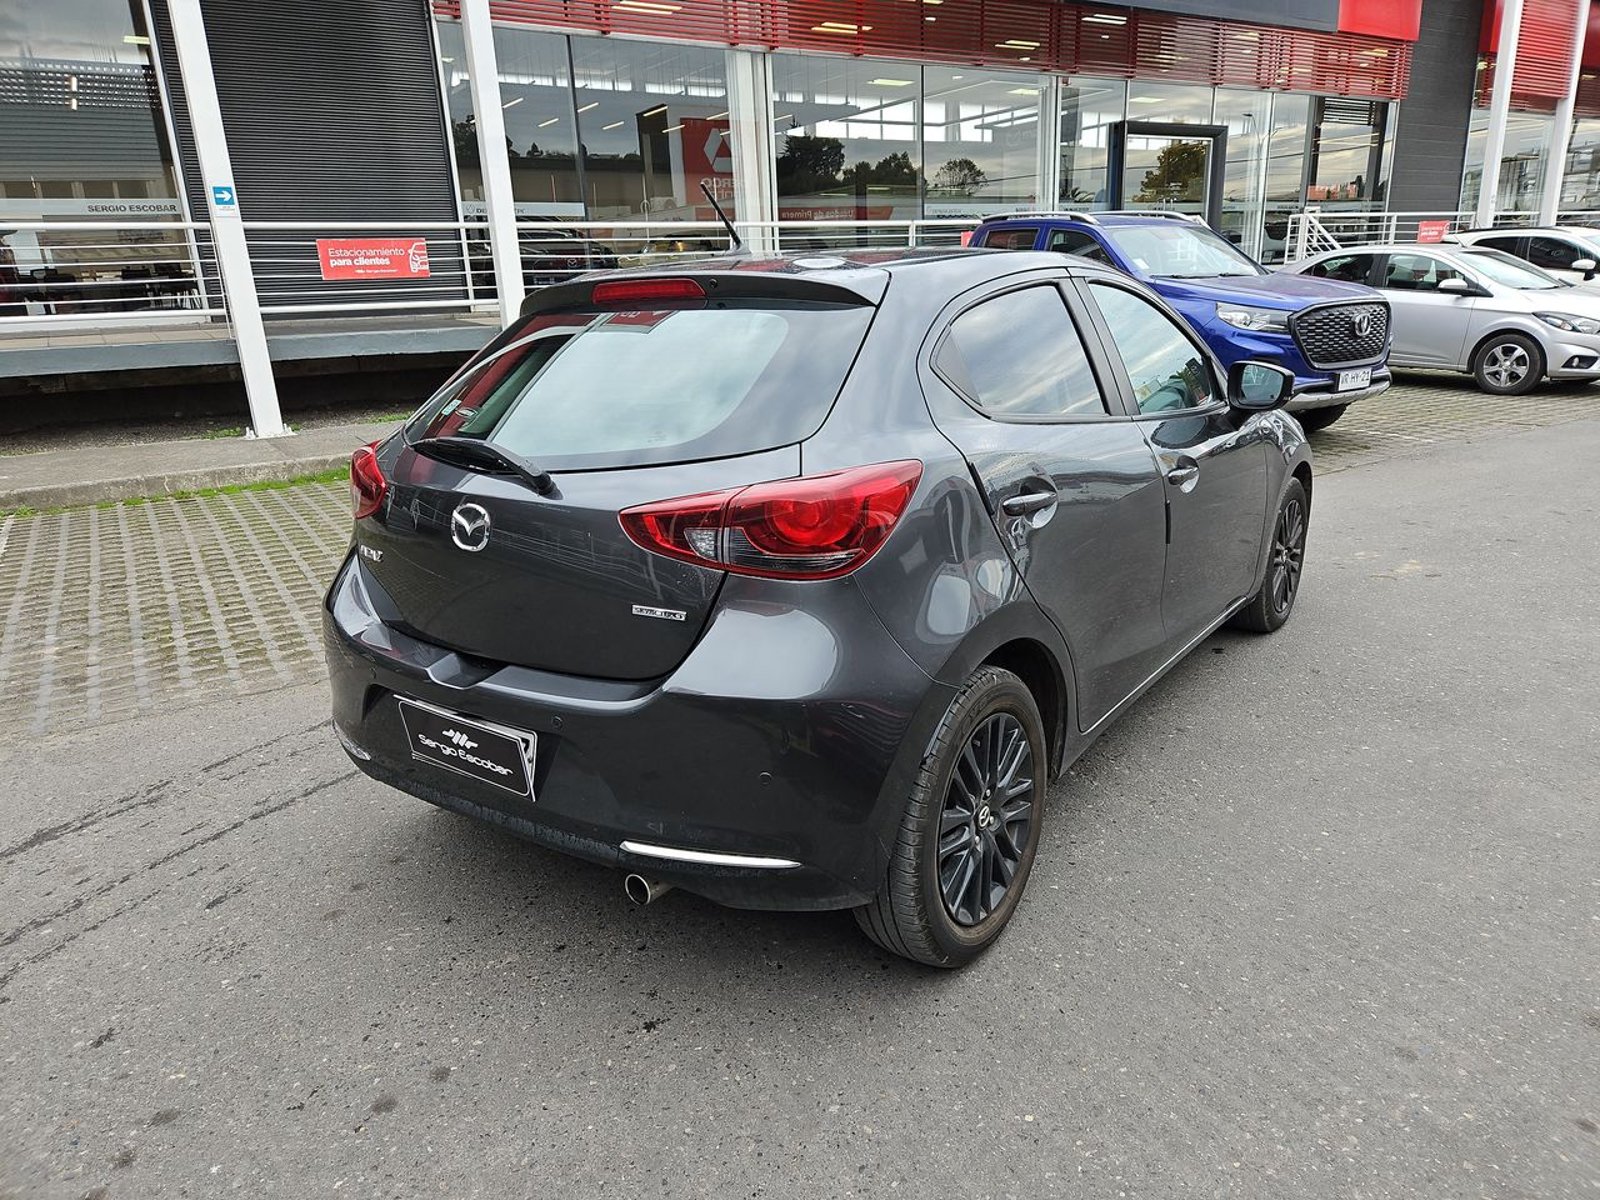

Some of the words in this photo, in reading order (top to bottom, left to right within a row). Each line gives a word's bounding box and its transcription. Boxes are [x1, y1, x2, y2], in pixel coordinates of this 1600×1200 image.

[88, 204, 127, 213] SERGIO
[129, 204, 177, 212] ESCOBAR
[328, 247, 405, 257] Estacionamiento
[330, 258, 352, 268] para
[354, 256, 391, 266] clientes
[418, 734, 457, 756] Sergio
[458, 749, 514, 776] Escobar
